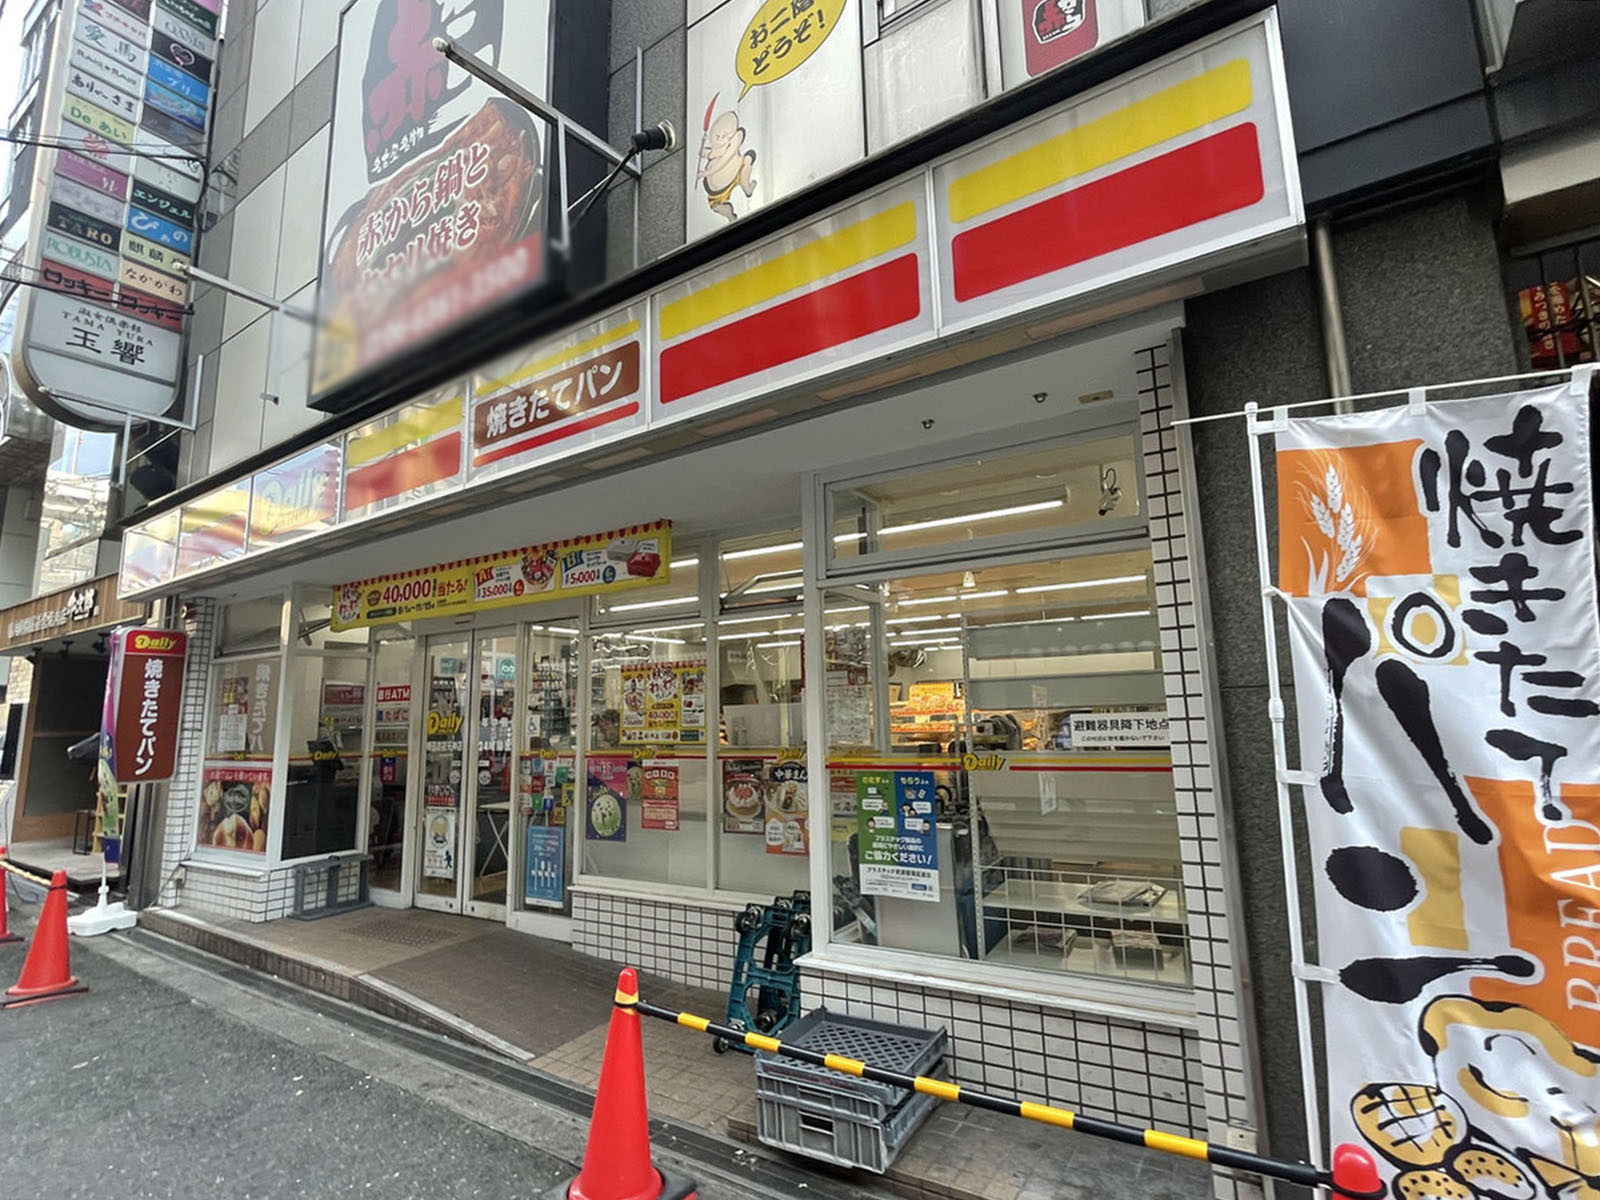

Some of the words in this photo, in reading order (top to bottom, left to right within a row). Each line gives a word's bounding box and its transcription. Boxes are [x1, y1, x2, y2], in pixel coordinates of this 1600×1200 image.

[357, 143, 490, 267] 赤から鍋と
[65, 326, 145, 366] 玉響
[486, 360, 623, 439] 焼きたてパン
[383, 578, 431, 604] 40,000
[1419, 404, 1600, 822] 焼きたて
[134, 634, 177, 650] Daily
[135, 658, 164, 776] 焼きたてパン
[427, 710, 463, 736] Daily
[1073, 718, 1170, 732] 避難器具降下地点
[963, 752, 1007, 772] Daily
[1321, 590, 1540, 1004] パン
[865, 850, 933, 865] ご協力ください!
